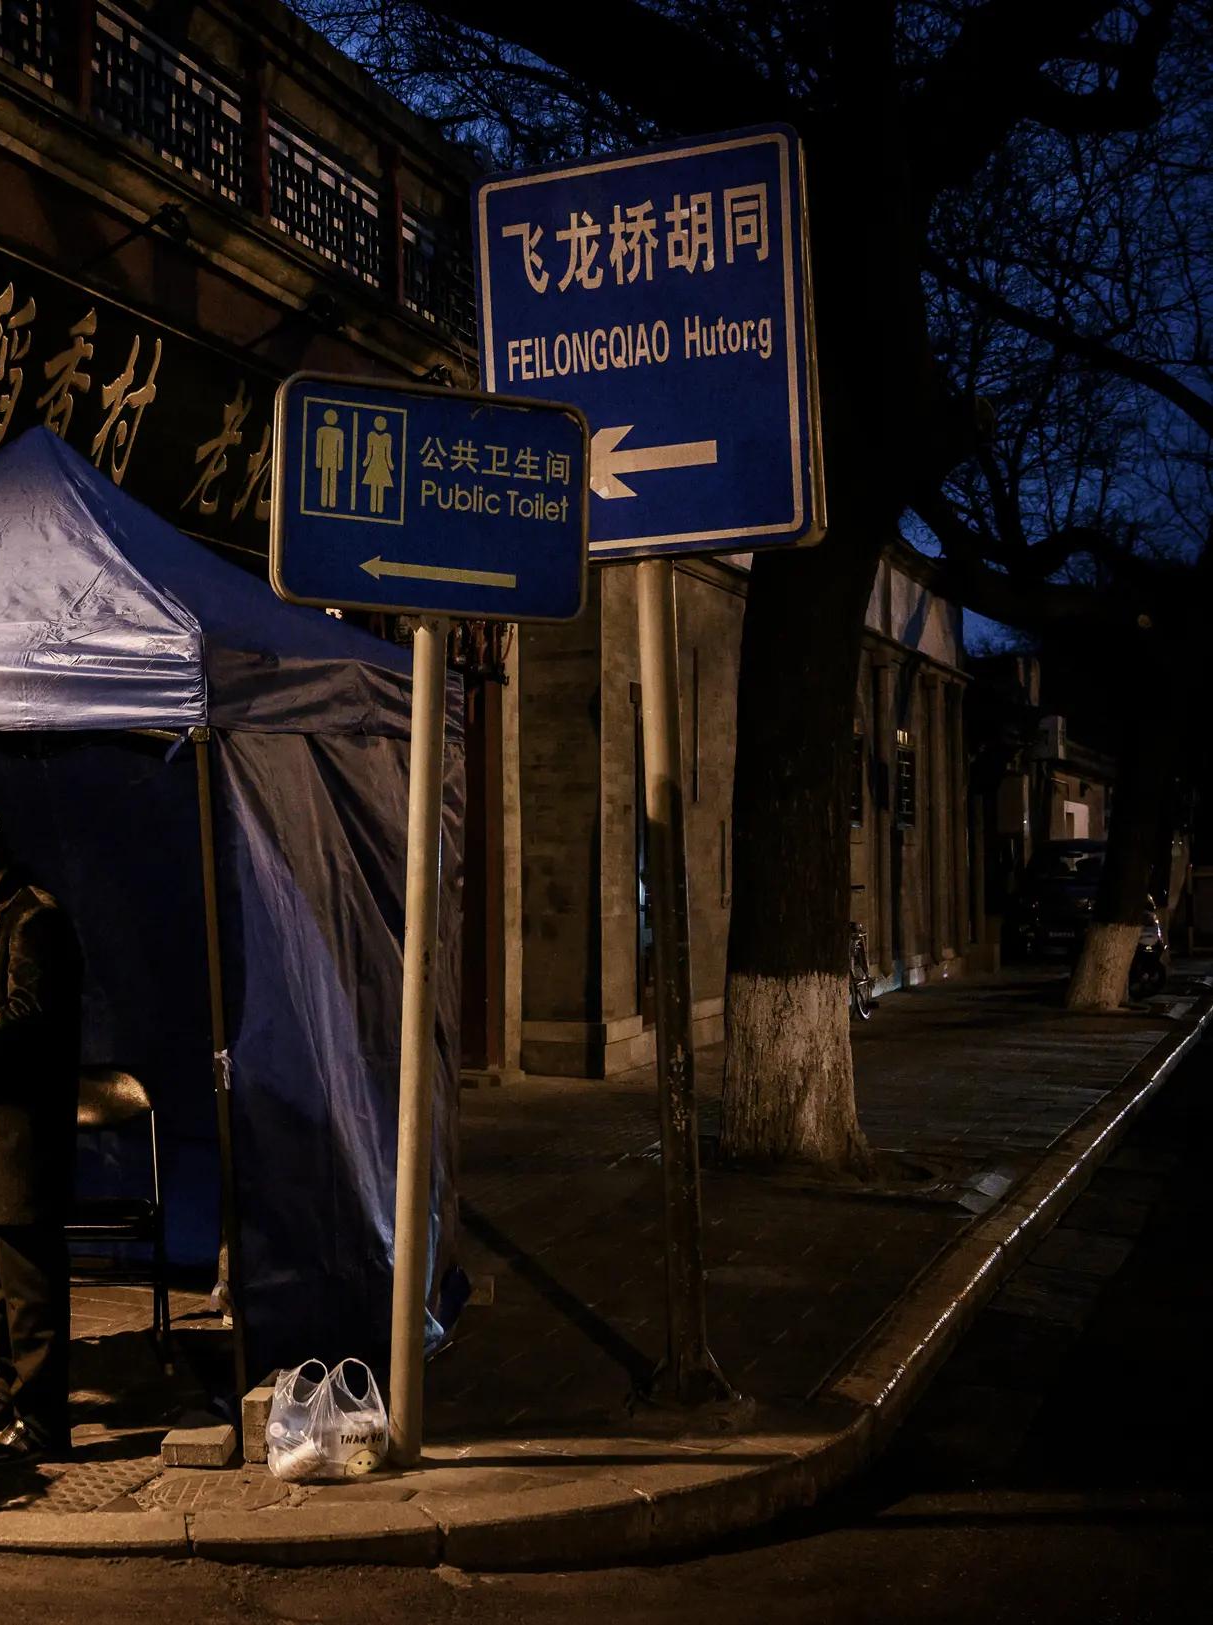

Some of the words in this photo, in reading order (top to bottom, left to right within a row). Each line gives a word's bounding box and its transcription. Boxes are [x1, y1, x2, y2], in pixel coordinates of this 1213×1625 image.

[502, 182, 770, 294] 飞龙桥胡同
[507, 320, 670, 382] FEILONGQIAO
[684, 316, 773, 360] Hutong
[418, 435, 571, 486] 公共卫生间
[420, 480, 501, 516] Public
[506, 489, 570, 524] Toilet
